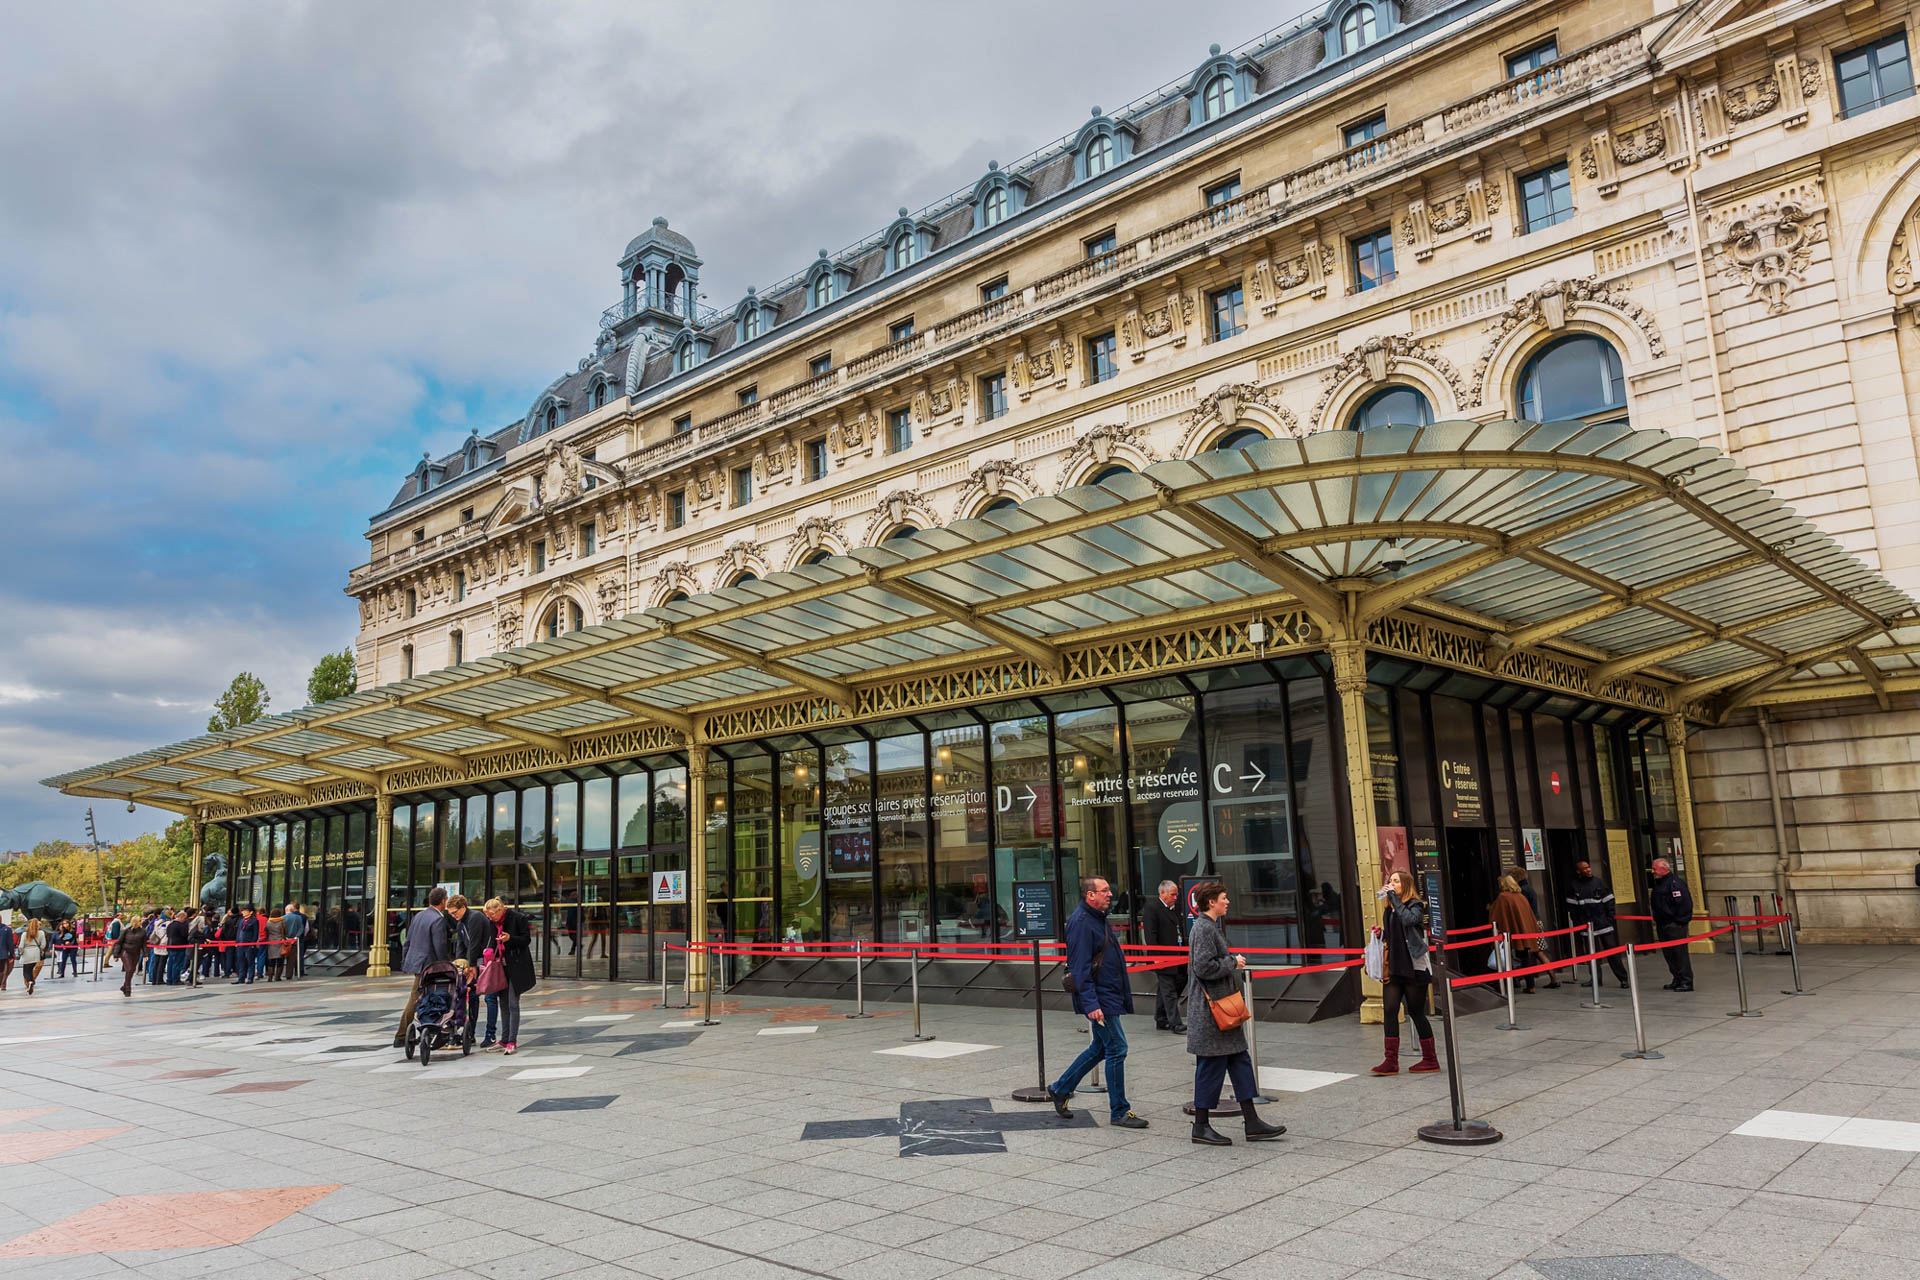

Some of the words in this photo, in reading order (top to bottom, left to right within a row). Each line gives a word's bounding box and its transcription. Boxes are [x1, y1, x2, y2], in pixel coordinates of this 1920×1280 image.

[1140, 767, 1198, 787] réservée
[1213, 763, 1232, 793] C
[1442, 760, 1451, 789] C
[1453, 762, 1470, 775] Entrée
[997, 786, 1012, 812] D
[1136, 791, 1161, 800] acceso
[1163, 787, 1199, 798] reservado
[823, 804, 857, 820] groupes
[903, 797, 925, 809] avec
[930, 788, 987, 807] réservation
[1071, 795, 1101, 806] Reserved
[830, 817, 846, 826] School
[877, 813, 907, 822] Reservation
[1018, 888, 1025, 898] C
[1019, 902, 1025, 912] 2
